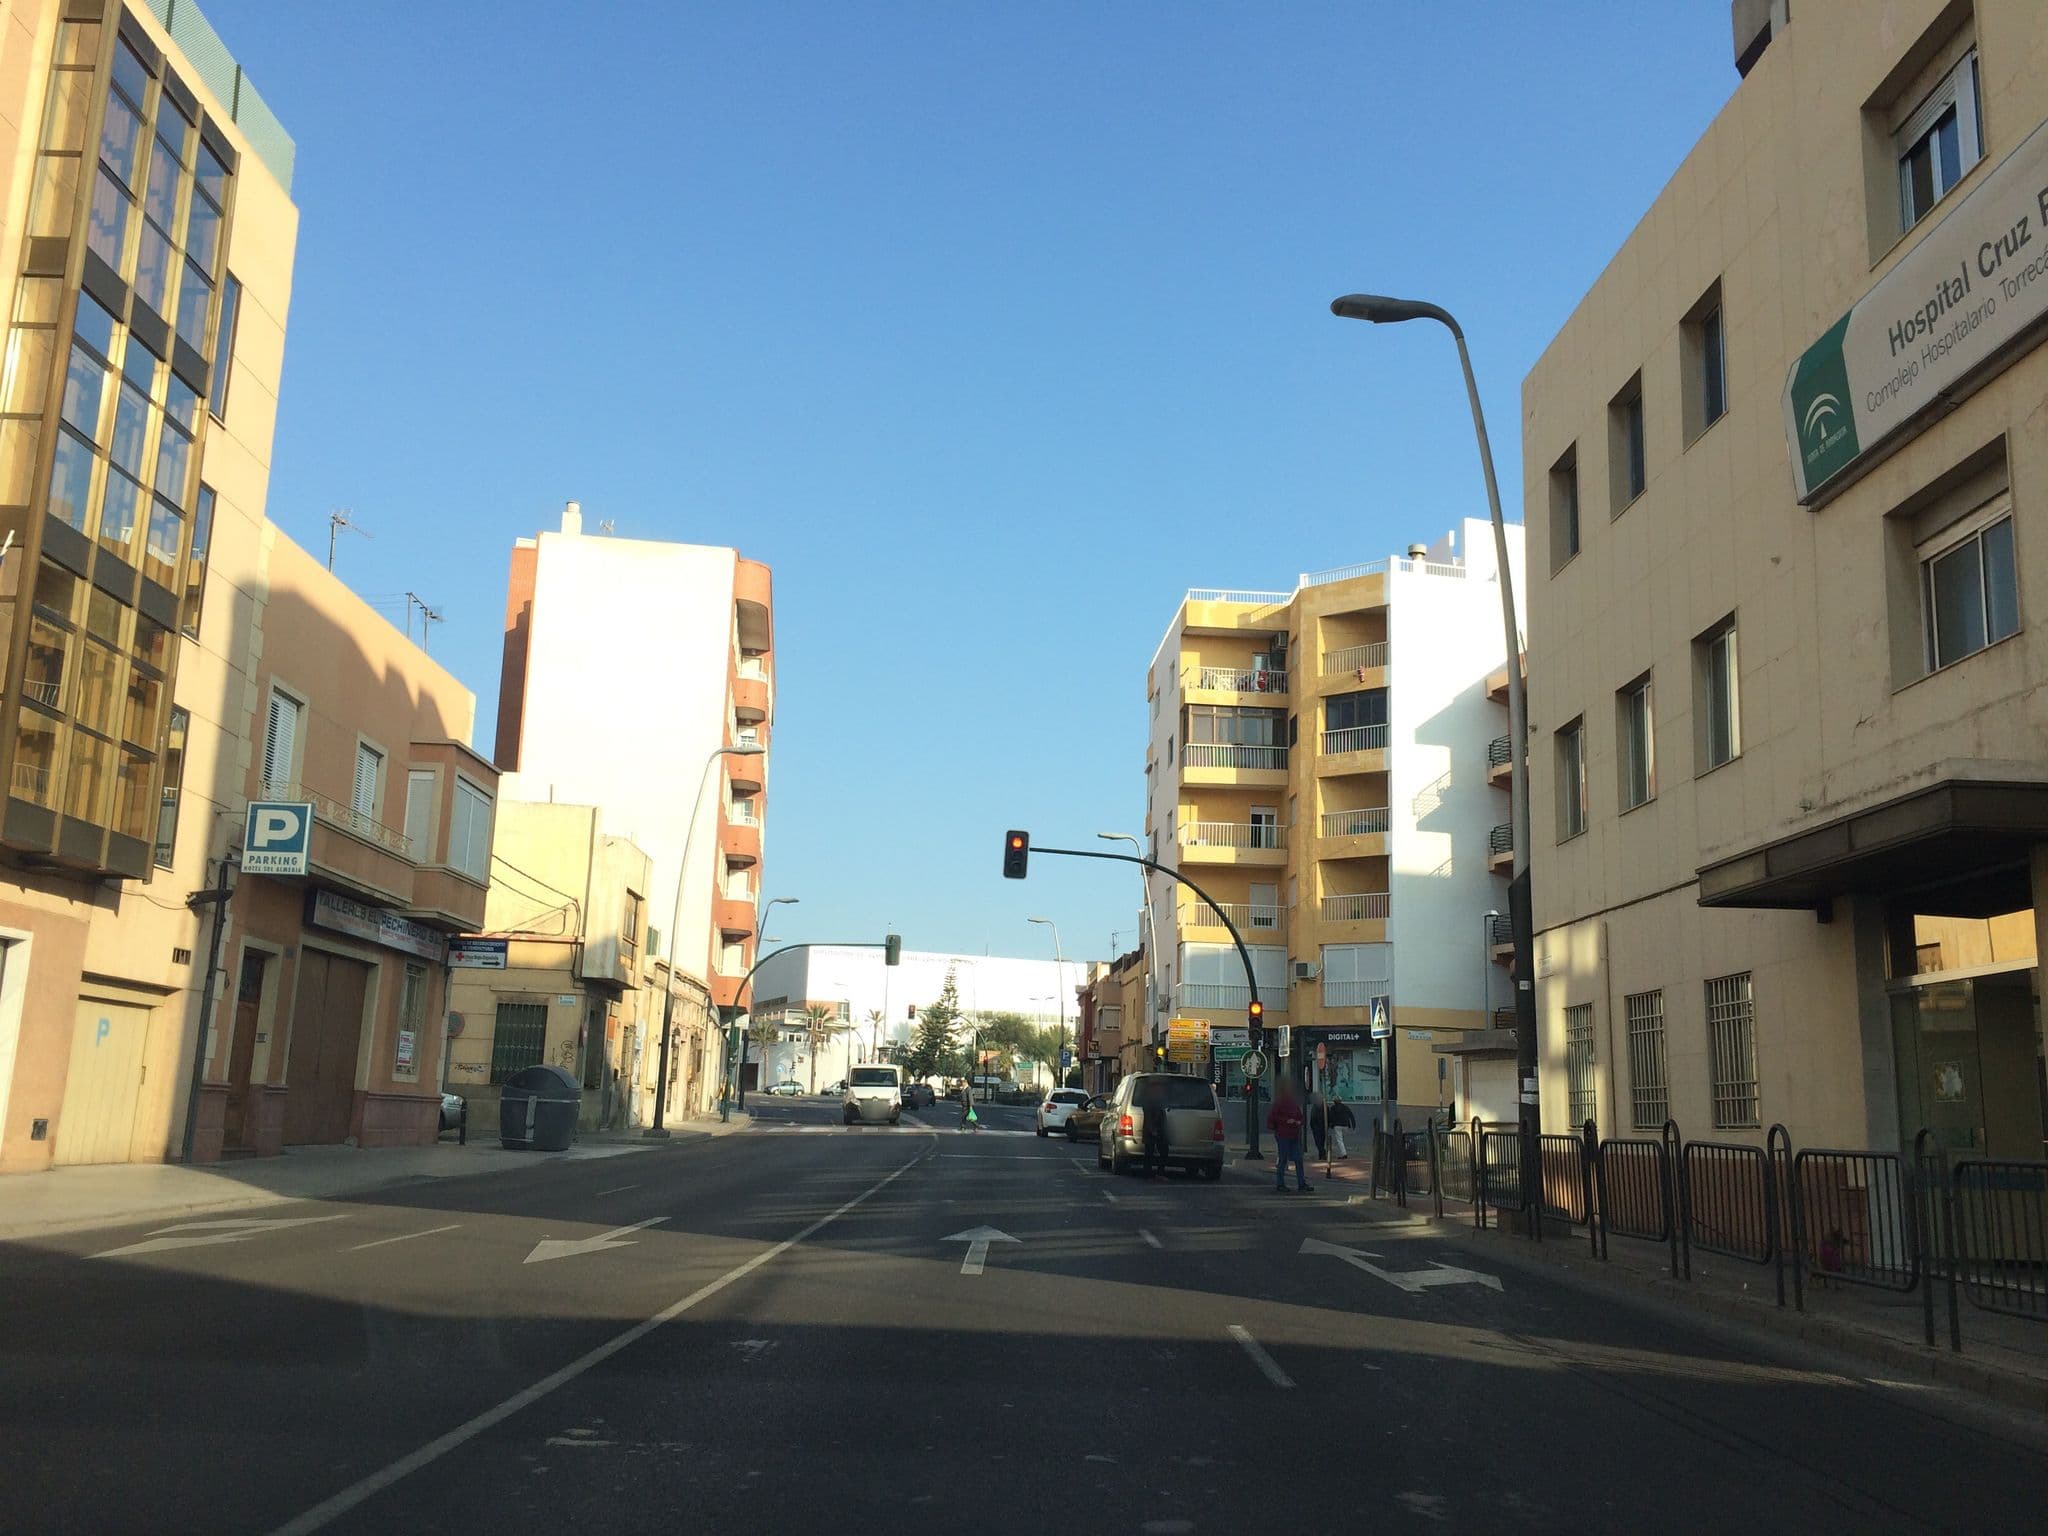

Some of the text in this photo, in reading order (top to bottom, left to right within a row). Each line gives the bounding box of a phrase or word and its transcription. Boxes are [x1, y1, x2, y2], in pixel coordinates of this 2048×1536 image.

[1888, 260, 1971, 357] Hospital
[1977, 215, 2032, 278] Cruz
[1866, 360, 1919, 413] Complejo
[1921, 297, 1996, 369] Hospitalario
[253, 809, 300, 848] P
[248, 855, 298, 866] PARKING
[1062, 1051, 1070, 1060] P
